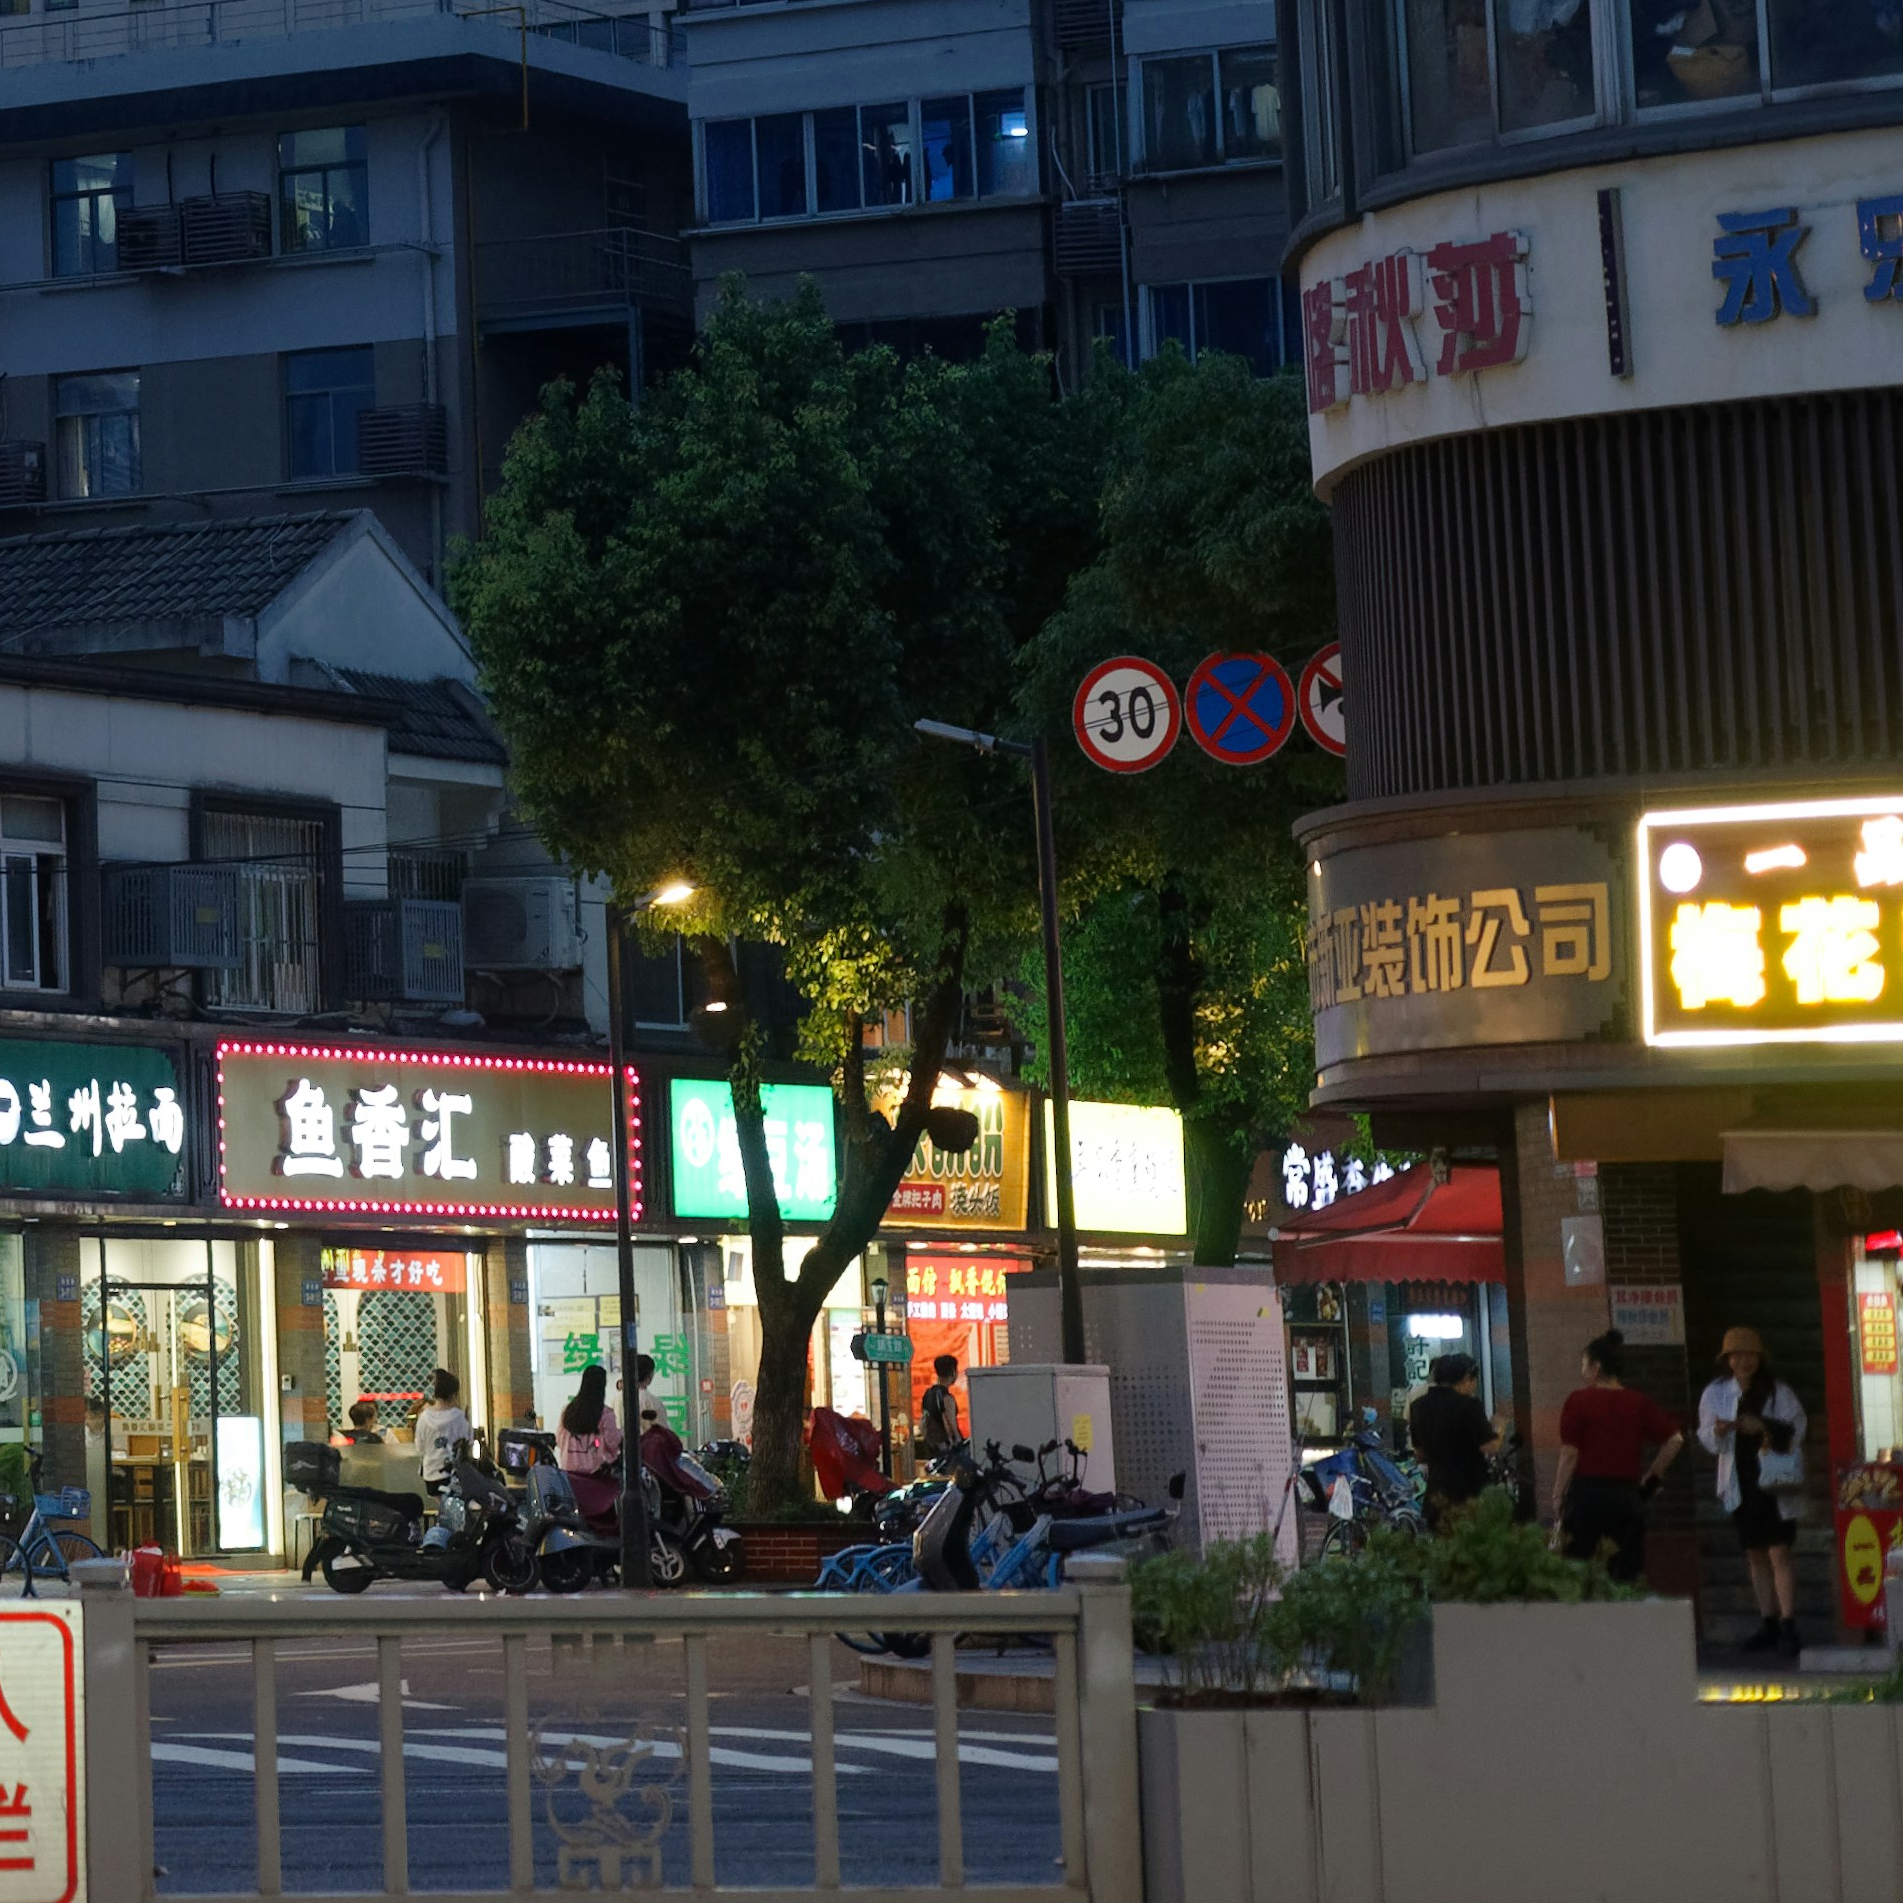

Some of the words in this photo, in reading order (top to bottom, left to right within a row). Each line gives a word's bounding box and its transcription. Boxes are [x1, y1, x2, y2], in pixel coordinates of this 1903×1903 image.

[1098, 685, 1156, 745] 30
[22, 1077, 186, 1159] 兰州拉面
[282, 1075, 478, 1180] 鱼香汇
[507, 1132, 612, 1189] 酸菜鱼
[322, 1257, 444, 1286] 鱼现杀才好吃
